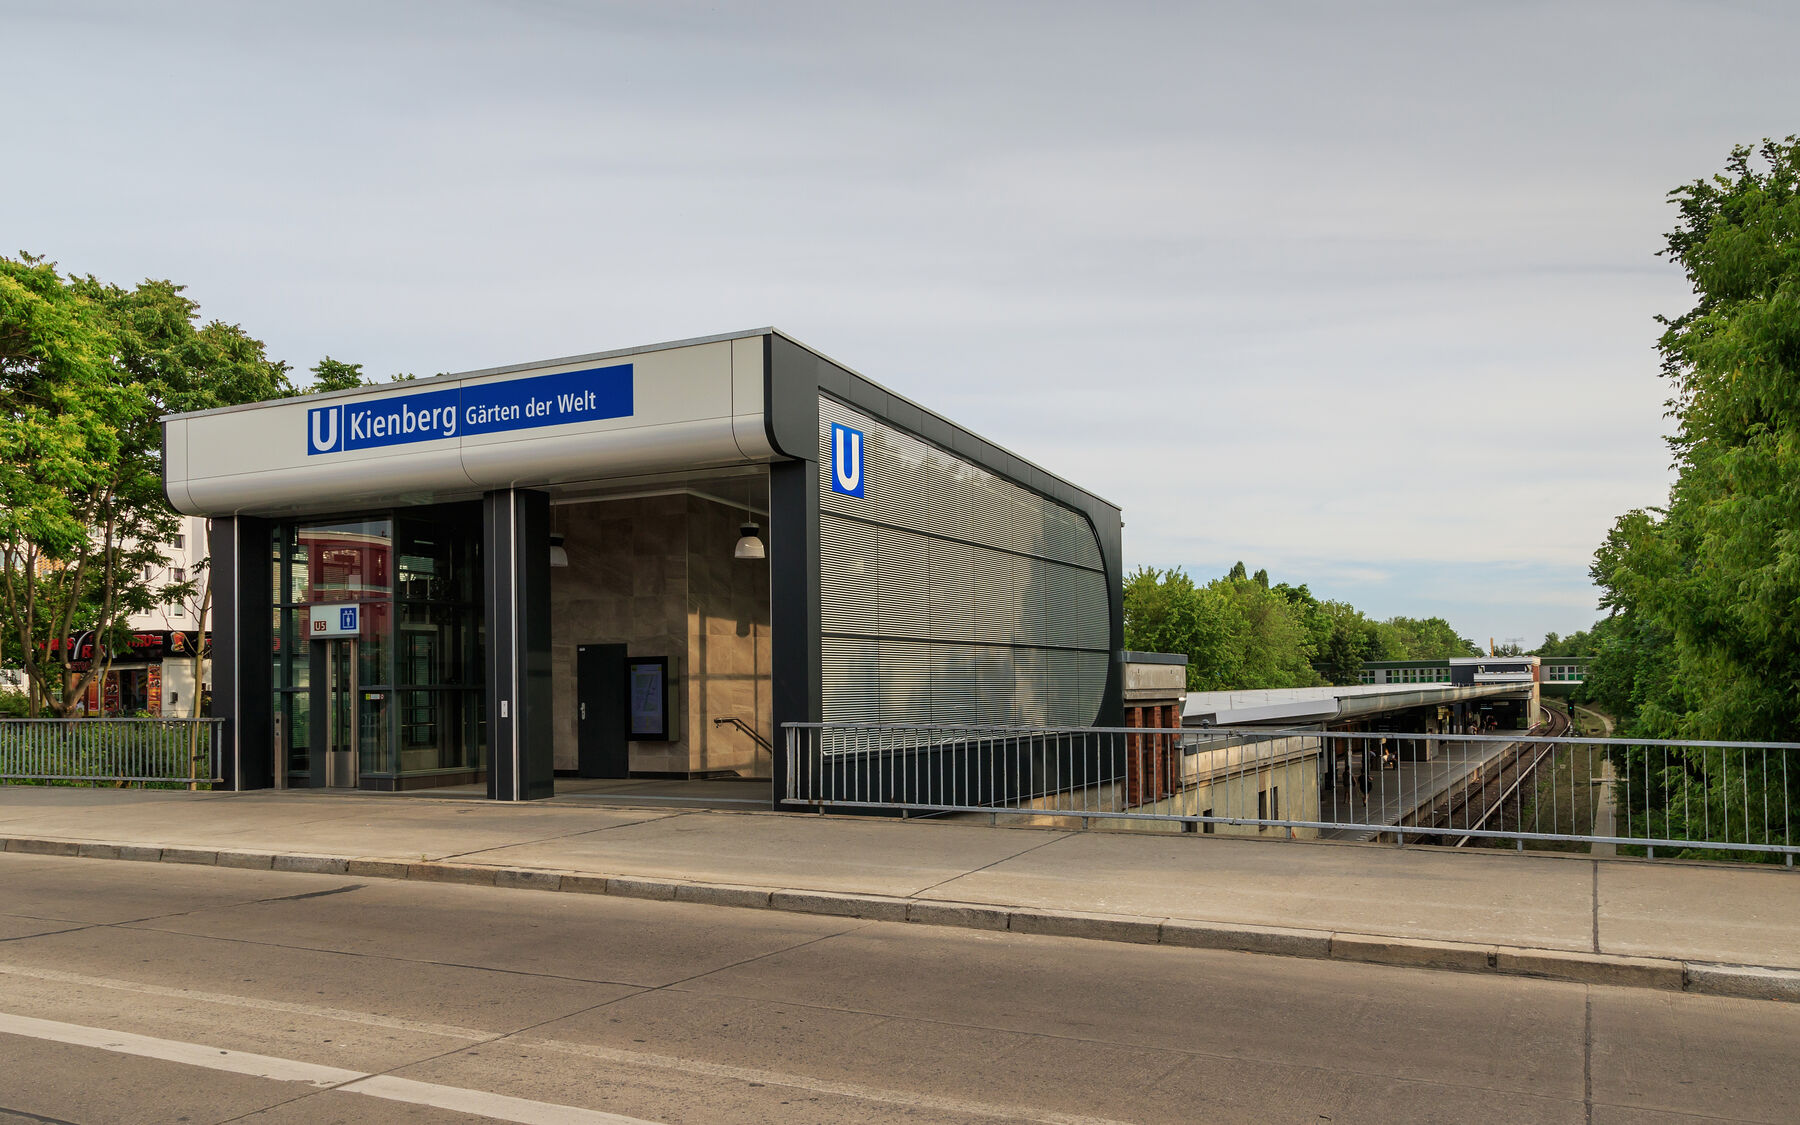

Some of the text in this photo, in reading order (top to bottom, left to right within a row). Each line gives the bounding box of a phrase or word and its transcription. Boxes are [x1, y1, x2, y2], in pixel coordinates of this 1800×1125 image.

[312, 390, 597, 452] U Kienberg Gärten der Welt
[836, 428, 860, 491] U
[315, 621, 326, 631] U5
